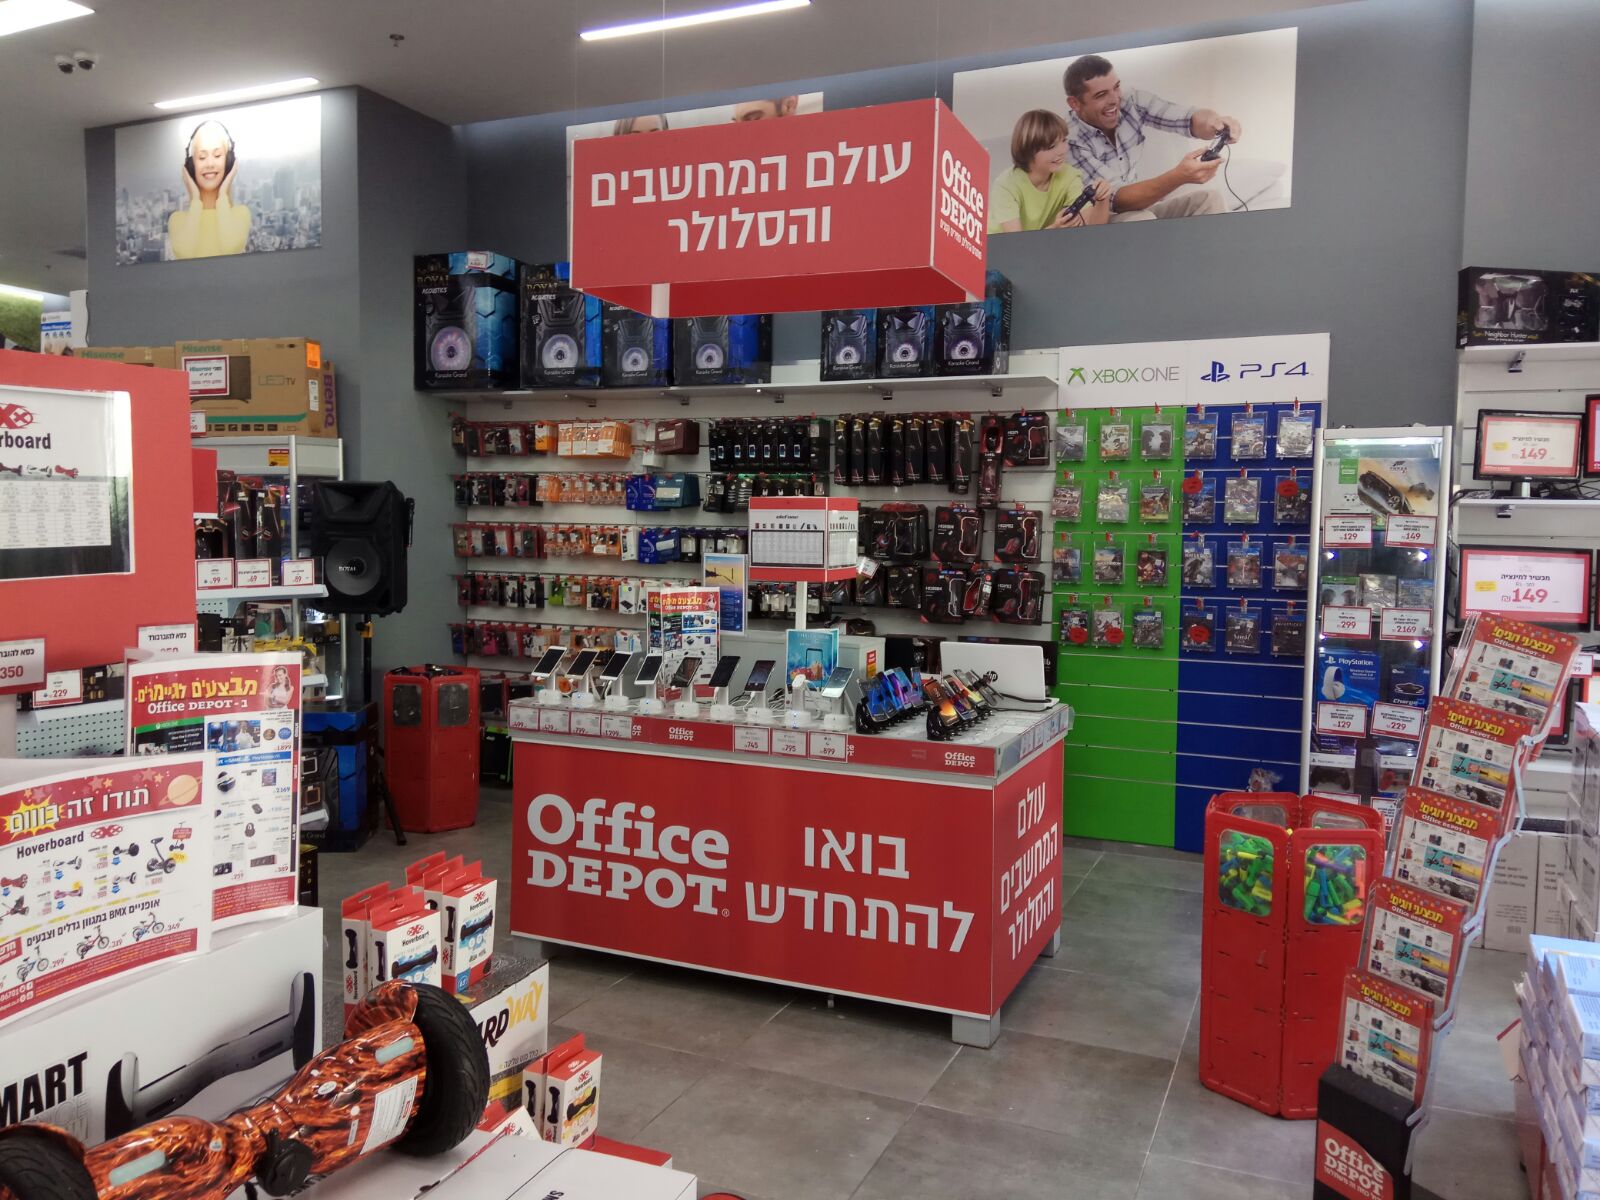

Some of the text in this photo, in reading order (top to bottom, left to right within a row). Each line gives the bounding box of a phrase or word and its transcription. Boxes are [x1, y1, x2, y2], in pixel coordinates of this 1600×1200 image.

[591, 141, 912, 207] עולם המחשבים
[942, 150, 984, 218] Office
[668, 206, 831, 252] והסלולר
[940, 187, 982, 245] DEPOT
[422, 287, 448, 295] ACOUSTICS
[531, 293, 556, 301] ACOUSTICS
[1091, 366, 1180, 384] XBOX ONE
[1239, 361, 1309, 379] PS4
[323, 374, 335, 428] BenQ
[1520, 448, 1547, 460] 149
[1406, 532, 1421, 540] 149
[1512, 588, 1548, 603] 149
[1341, 621, 1356, 629] 299
[21, 648, 35, 656] כסא
[1338, 658, 1373, 666] PlayStation
[53, 689, 67, 698] 229
[137, 676, 258, 703] מבצעים לגיימרים
[147, 700, 185, 714] Office
[188, 700, 233, 711] DEPOT
[668, 726, 694, 736] Office
[668, 733, 694, 741] DEPOT
[1391, 721, 1406, 730] 229
[944, 752, 975, 762] Office
[944, 760, 975, 768] DEPOT
[10, 788, 149, 834] תודו זה בווום
[1017, 782, 1046, 839] עולם
[17, 830, 84, 859] Hoverboard
[527, 793, 730, 869] Office
[804, 826, 911, 880] בואו
[1001, 821, 1058, 915] המחשבים
[526, 849, 728, 916] DEPOT
[26, 899, 161, 946] אופניים BMX במגוון גדלים וצבעים
[744, 881, 975, 953] להתחדש
[1008, 877, 1054, 961] והסלולר
[1324, 1138, 1384, 1184] Office
[1324, 1152, 1384, 1196] DEPOT
